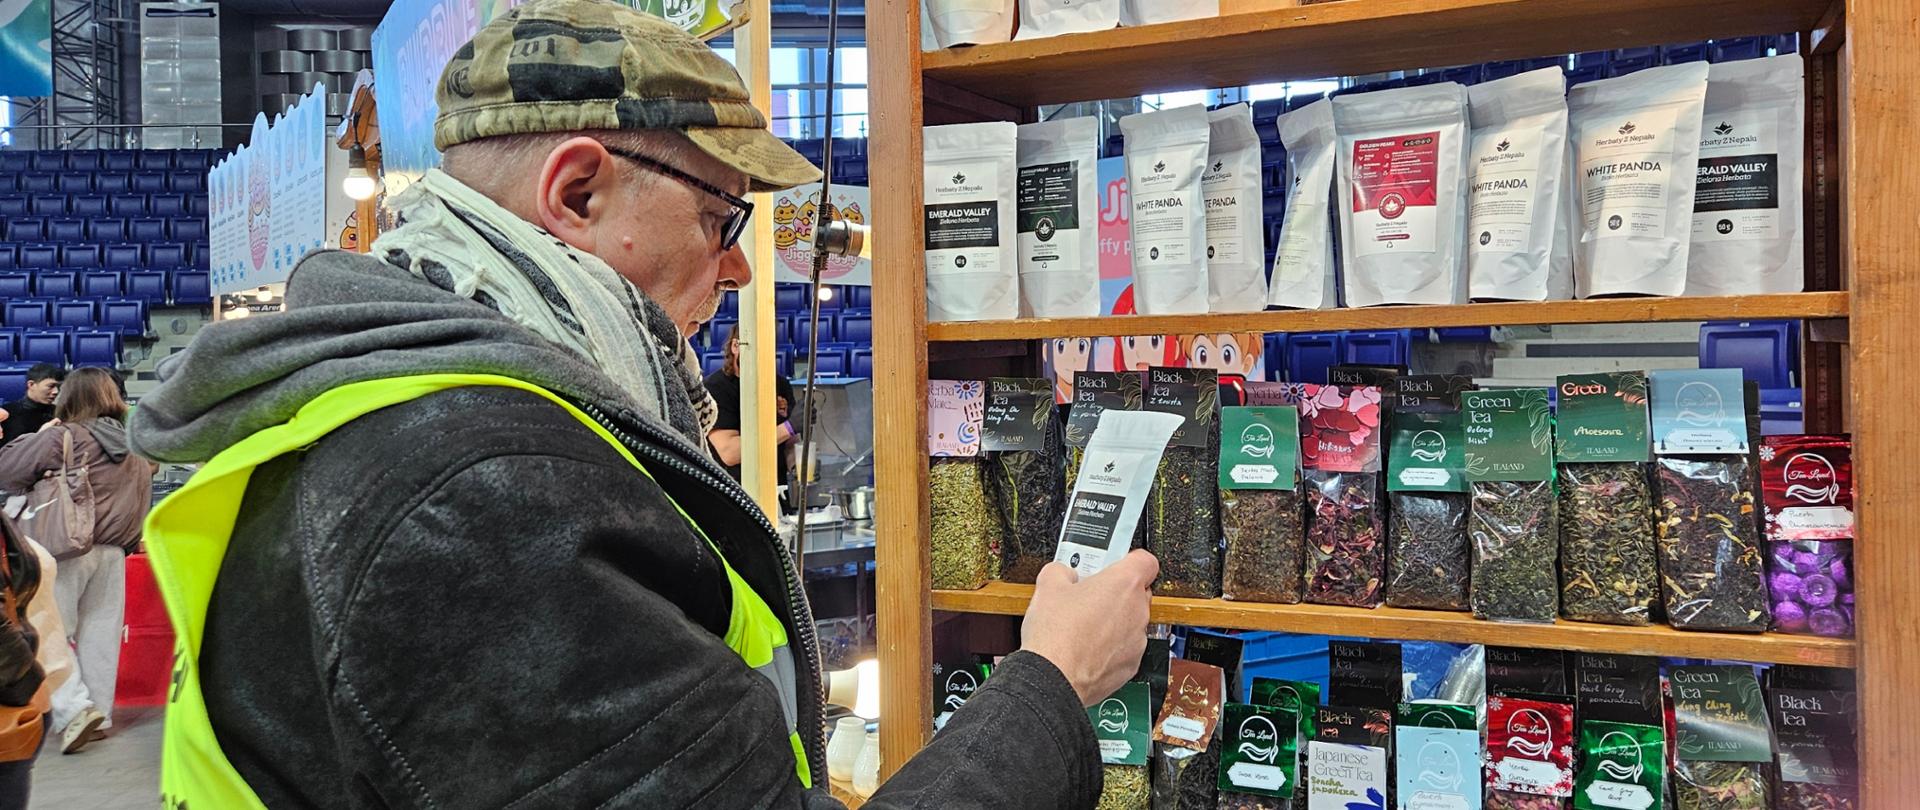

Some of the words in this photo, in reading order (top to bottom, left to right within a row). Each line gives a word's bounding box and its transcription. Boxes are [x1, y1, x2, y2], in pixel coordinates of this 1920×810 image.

[1595, 138, 1622, 147] Herbaty
[1629, 133, 1656, 143] Nepalu
[1729, 135, 1758, 144] Nepalu
[1586, 164, 1617, 178] WHITE
[1619, 161, 1662, 172] PANDA
[1730, 162, 1768, 173] VALLEY
[1722, 174, 1752, 182] Herbata
[1472, 181, 1493, 193] WHITE
[1494, 178, 1529, 190] PANDA
[1136, 199, 1155, 211] WHITE
[1155, 197, 1183, 209] PANDA
[1212, 196, 1237, 207] PANDA
[929, 208, 962, 219] EMERALD
[964, 207, 992, 216] VALLEY
[787, 247, 813, 262] Jigg
[1078, 376, 1107, 388] Black
[1153, 370, 1183, 383] Black
[1333, 370, 1363, 383] Black
[993, 381, 1021, 392] Black
[1152, 385, 1170, 397] Tea
[1400, 380, 1433, 392] Black
[1561, 382, 1607, 396] Green
[992, 394, 1009, 405] Tea
[1077, 390, 1095, 402] Tea
[1252, 386, 1282, 400] Yerba
[1400, 395, 1420, 406] Tea
[1467, 395, 1511, 409] Green
[1469, 411, 1492, 424] Tea
[1788, 470, 1807, 480] Tea
[1808, 468, 1831, 481] Land
[1075, 498, 1097, 510] EMERALD
[1096, 501, 1117, 513] VALLEY
[1334, 644, 1365, 658] Black
[1487, 650, 1521, 662] Black
[1335, 658, 1353, 670] Tea
[1581, 656, 1617, 669] Black
[1488, 663, 1508, 676] Tea
[1674, 669, 1719, 683] Green
[1583, 670, 1603, 683] Tea
[949, 683, 961, 691] Tea
[961, 683, 975, 692] Land
[1677, 686, 1702, 699] Tea
[1779, 694, 1822, 711] Black
[1319, 709, 1353, 725] Black
[1780, 711, 1807, 726] Tea
[1242, 728, 1256, 738] Tea
[1257, 729, 1274, 741] Land
[1321, 728, 1339, 738] Tea
[1511, 724, 1527, 734] Tea
[1528, 724, 1548, 736] Land
[1314, 747, 1369, 766] Japanese
[1314, 762, 1352, 778] Green
[1355, 766, 1373, 782] Tea
